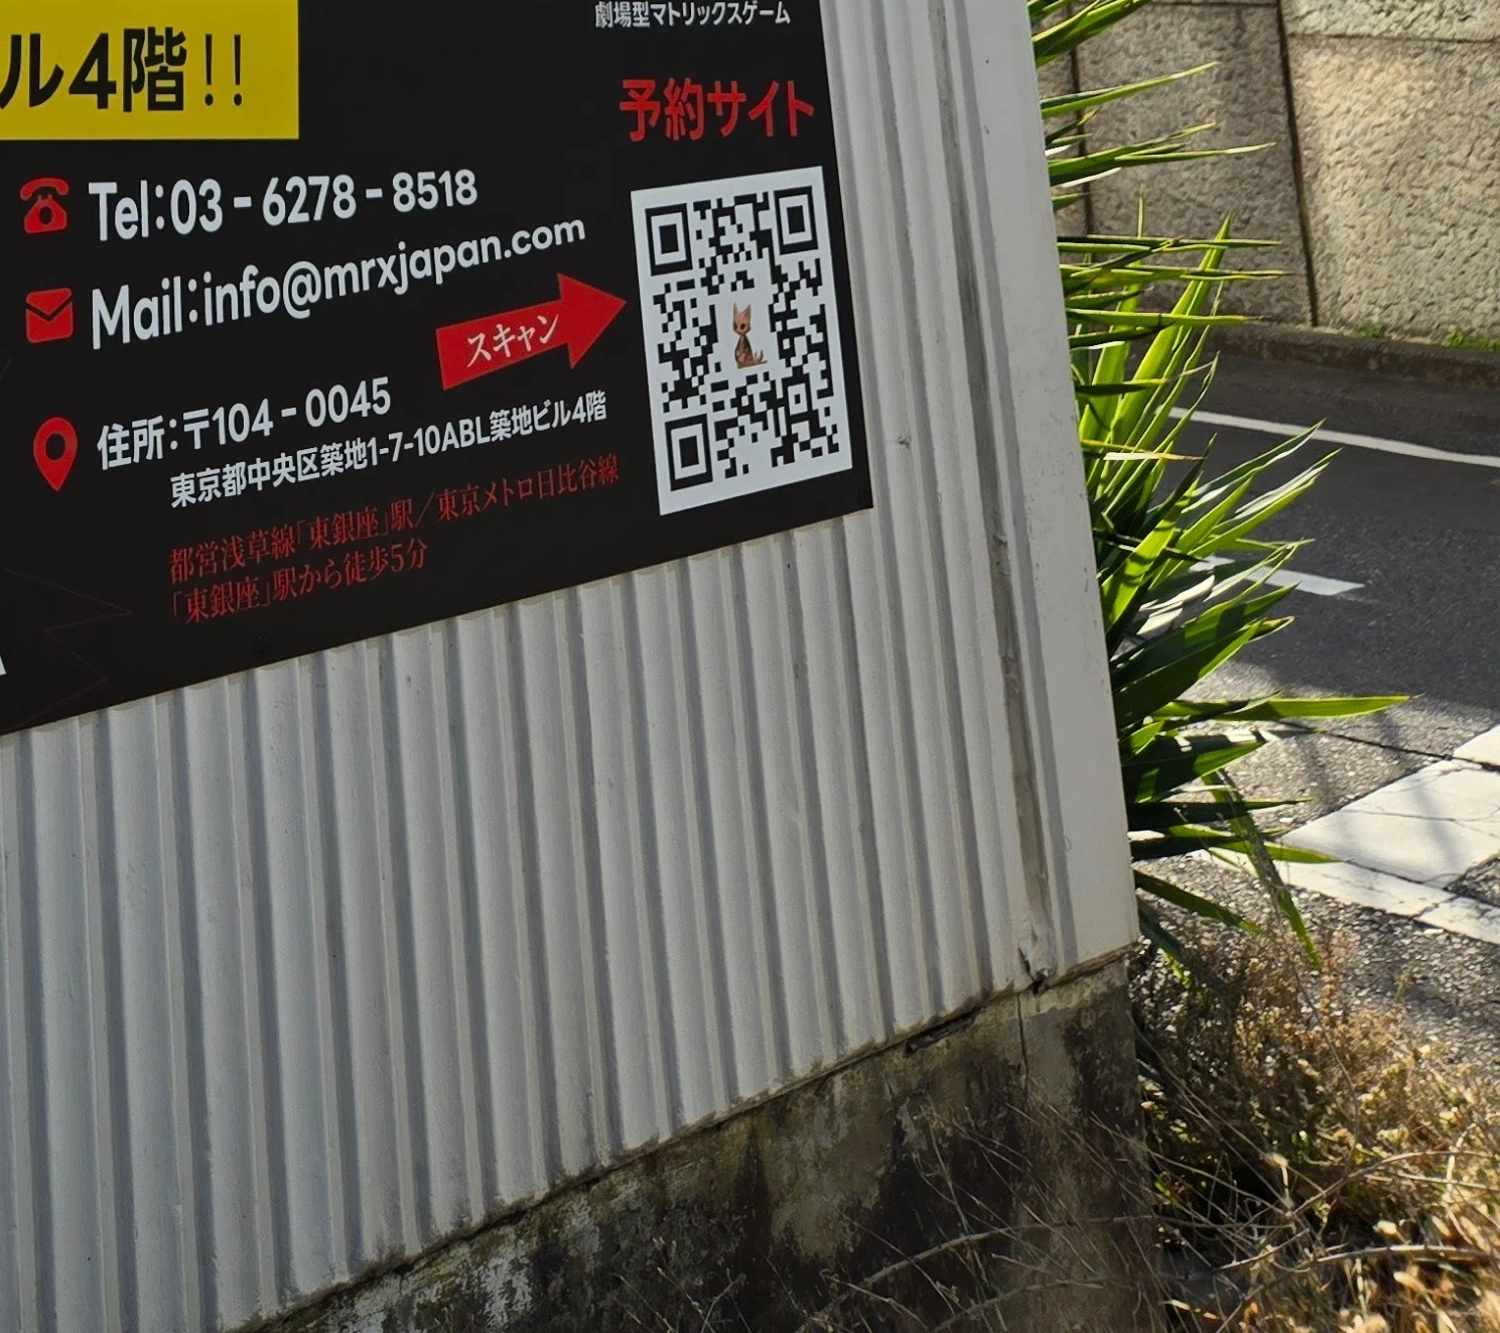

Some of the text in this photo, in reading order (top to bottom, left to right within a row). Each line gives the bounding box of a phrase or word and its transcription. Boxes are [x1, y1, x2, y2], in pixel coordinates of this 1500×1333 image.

[594, 0, 791, 29] 劇場型マトリックスゲーム
[619, 76, 815, 142] 予約サイト
[91, 218, 586, 350] Mail:info@mrxjapan.com
[466, 314, 560, 368] スキャン
[170, 390, 607, 509] 東京都中央区築地1-7-10ABL築地ビル4階
[172, 538, 428, 624] 「東銀座」駅から徒歩5分
